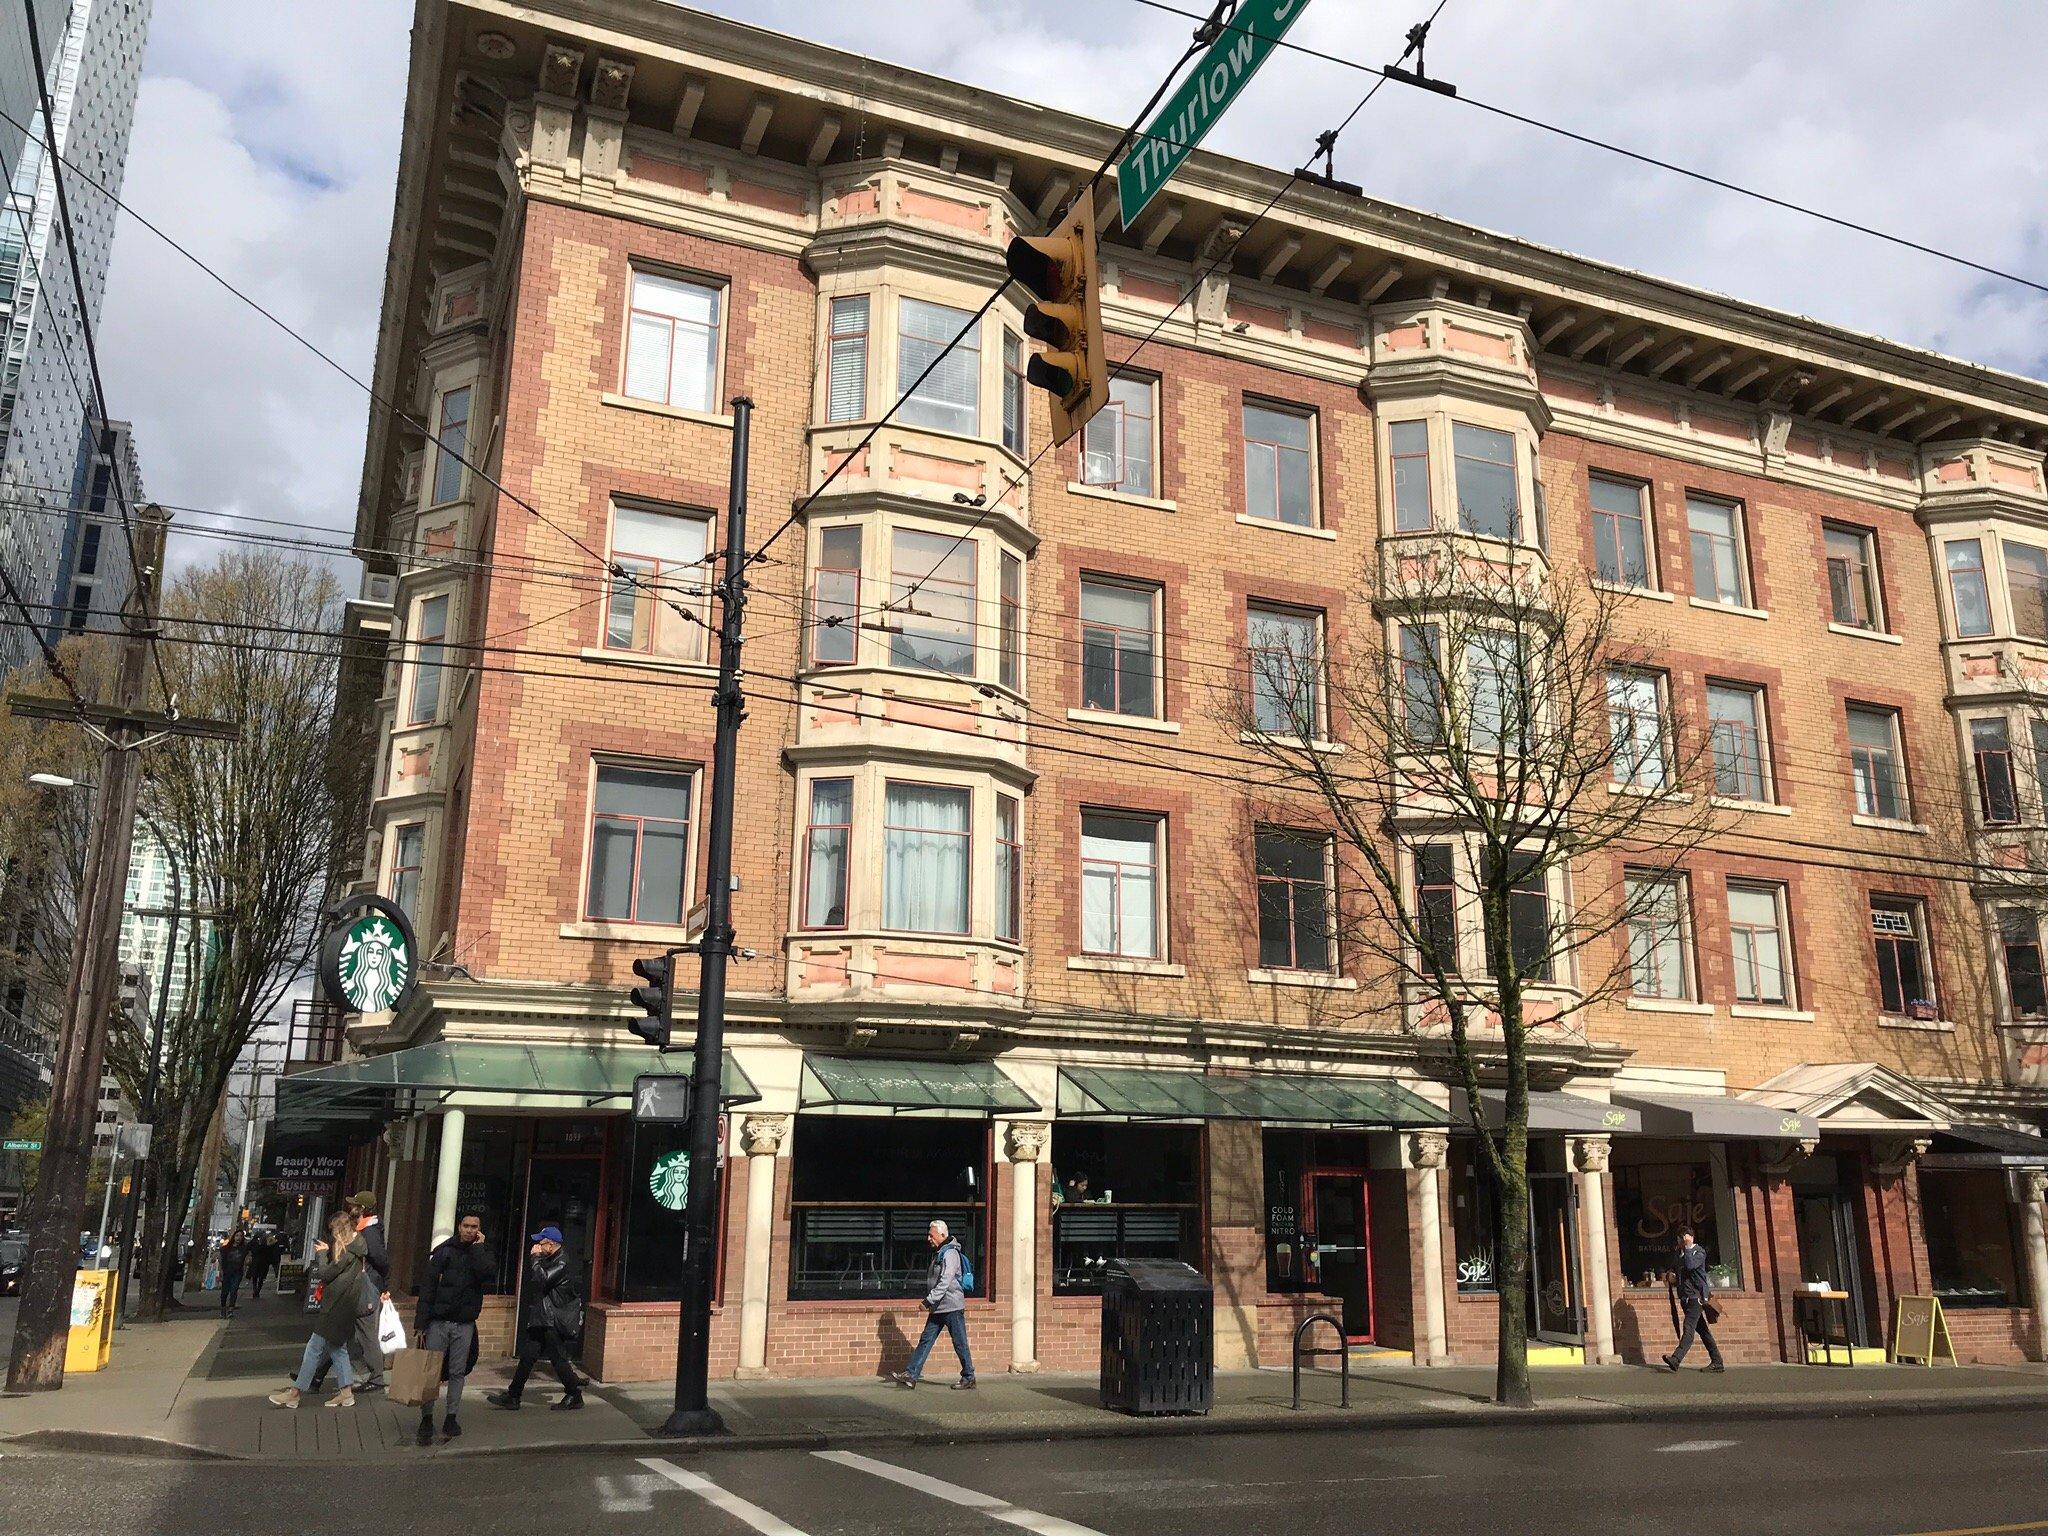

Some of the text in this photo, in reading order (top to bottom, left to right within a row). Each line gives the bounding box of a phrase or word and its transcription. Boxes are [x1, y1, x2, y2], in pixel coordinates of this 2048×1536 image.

[1132, 21, 1254, 194] Thurlow
[1602, 1111, 1627, 1126] Saje
[1780, 1117, 1802, 1131] Saje
[275, 1156, 344, 1169] Beauty Worx
[281, 1167, 335, 1177] Spa & Nails
[280, 1181, 310, 1191] SUSHI
[1271, 1206, 1294, 1214] COLD
[1271, 1214, 1294, 1222] FOAM
[1637, 1195, 1708, 1239] Saje
[1271, 1227, 1296, 1235] NITRO
[1456, 1261, 1488, 1283] Saje
[1901, 1311, 1929, 1327] Saje
